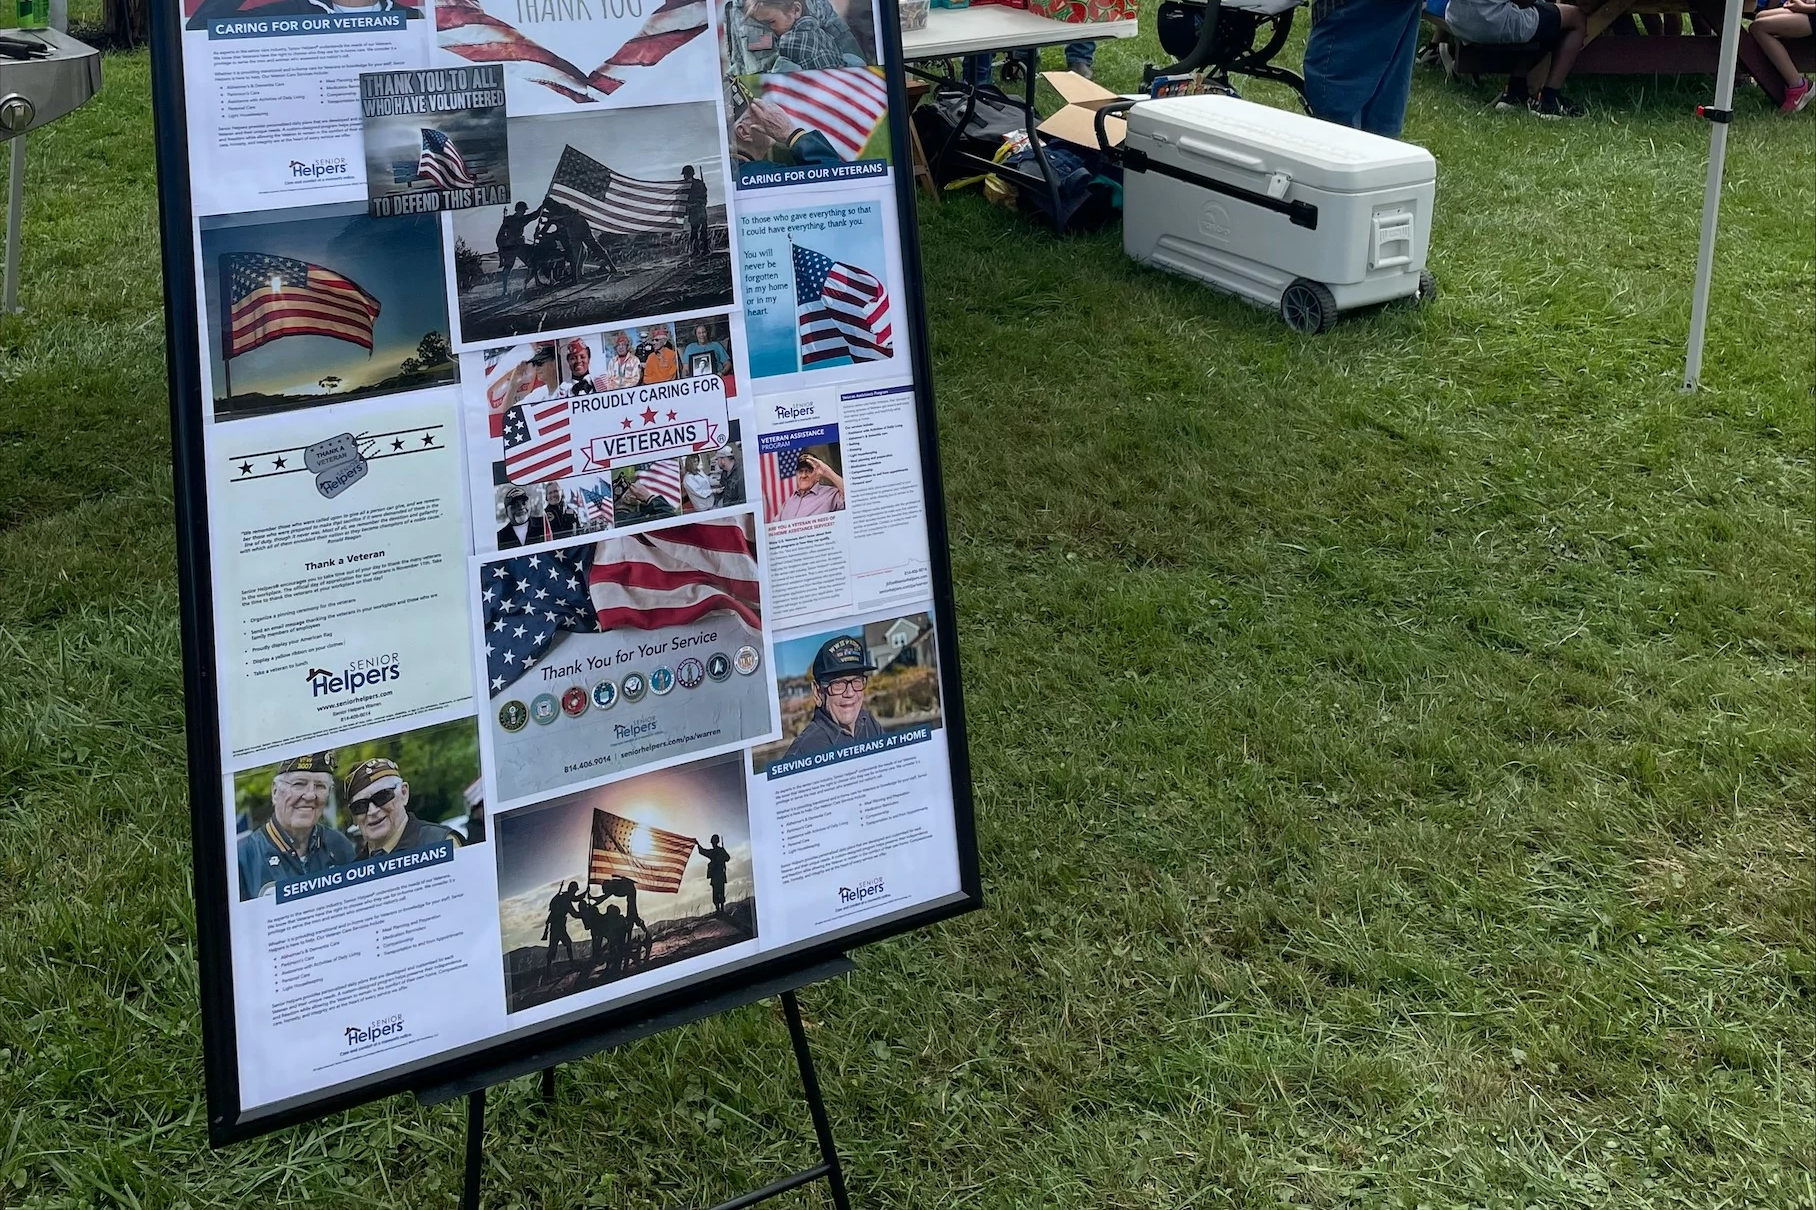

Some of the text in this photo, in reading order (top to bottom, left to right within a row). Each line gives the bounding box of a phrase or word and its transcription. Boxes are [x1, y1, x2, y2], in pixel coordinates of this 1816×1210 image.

[215, 15, 400, 35] CARING FOR OUR VETERANS
[365, 75, 415, 99] THANK
[417, 71, 446, 92] YOU
[447, 71, 467, 93] TO
[472, 69, 497, 89] ALL
[362, 90, 505, 117] WHO HAVE VOLUNTEERED
[293, 164, 347, 178] Helpers
[315, 158, 346, 166] SENIOR
[741, 163, 883, 186] CARING FOR OUR VETERANS
[373, 187, 510, 215] TO DEFEND THIS FLAG!
[740, 216, 750, 225] To
[751, 216, 771, 224] those
[773, 213, 789, 222] who
[790, 213, 807, 223] gave
[809, 208, 847, 219] everything
[857, 206, 871, 214] that
[741, 228, 745, 236] I
[746, 226, 766, 236] could
[768, 226, 785, 234] have
[827, 218, 847, 228] thank
[743, 248, 773, 259] You will
[744, 260, 776, 271] never be
[745, 273, 779, 283] forgotten
[745, 283, 788, 294] in my home
[746, 298, 755, 306] or
[765, 296, 777, 304] my
[572, 375, 722, 415] PROUDLY CARING FOR
[778, 407, 815, 419] Helpers
[603, 425, 696, 457] VETERANS
[760, 428, 825, 444] VETERAN ASSISTANCE
[761, 440, 791, 450] PROGRAM
[316, 447, 339, 458] THANK
[317, 452, 347, 466] VETERAN
[324, 464, 362, 494] Helpers
[304, 558, 336, 571] Thank
[346, 550, 385, 563] Veteran
[300, 634, 323, 642] American
[252, 657, 270, 665] Display
[275, 653, 291, 661] yellow
[350, 653, 399, 671] SENIOR
[541, 631, 718, 681] Thank You for Your Service
[313, 665, 400, 697] Helpers
[316, 690, 393, 712] www.seniorhelpers.com
[616, 721, 657, 739] Helpers
[621, 729, 721, 759] seniorhelpers.com/pa/warren
[771, 728, 927, 775] SERVING OUR VETERANS AT HOME
[564, 755, 611, 774] 814.406.9014
[283, 846, 447, 897] SERVING OUR VETERANS
[859, 877, 883, 888] SENIOR
[841, 883, 884, 903] Helpers
[372, 1014, 403, 1028] SENIOR
[349, 1021, 404, 1045] Helpers
